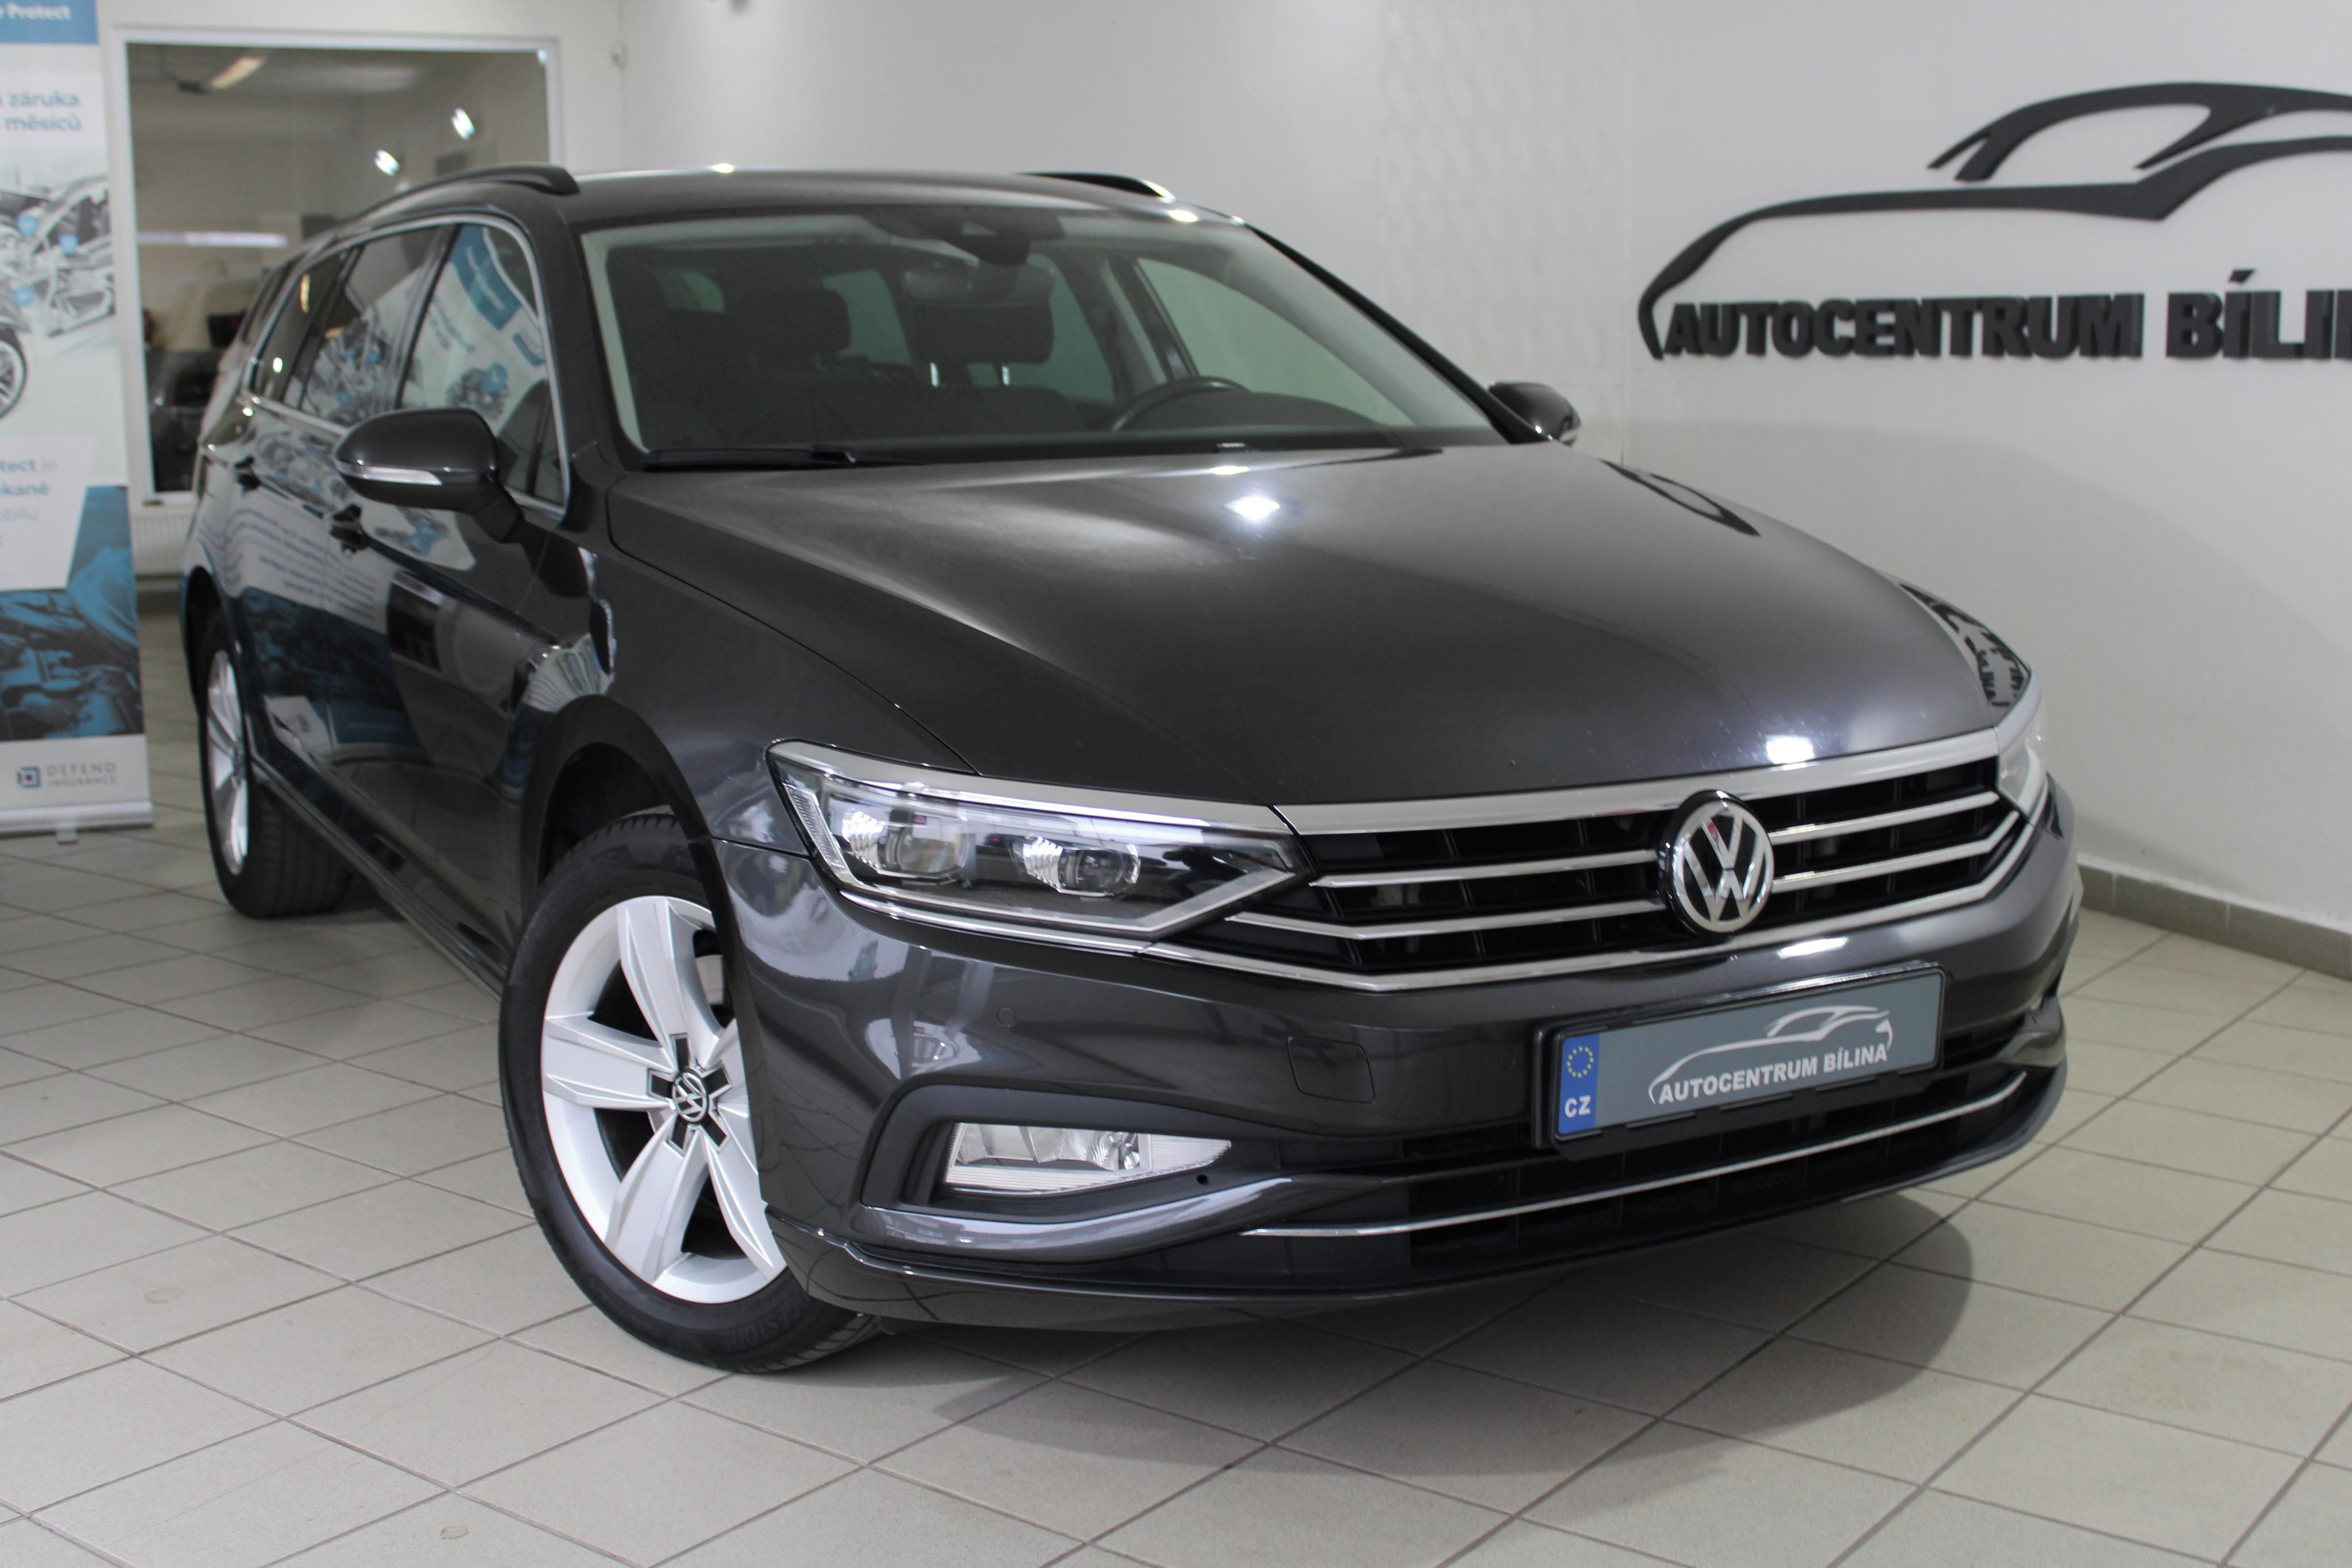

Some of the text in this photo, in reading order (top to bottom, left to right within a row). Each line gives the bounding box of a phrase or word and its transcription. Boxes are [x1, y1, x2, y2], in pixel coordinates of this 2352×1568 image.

[1662, 292, 2146, 362] AUTOCENTRUM
[47, 761, 116, 776] DEFEND
[1658, 1042, 1888, 1105] AUTOCENTRUM BÍLINA
[1564, 1094, 1591, 1118] CZ
